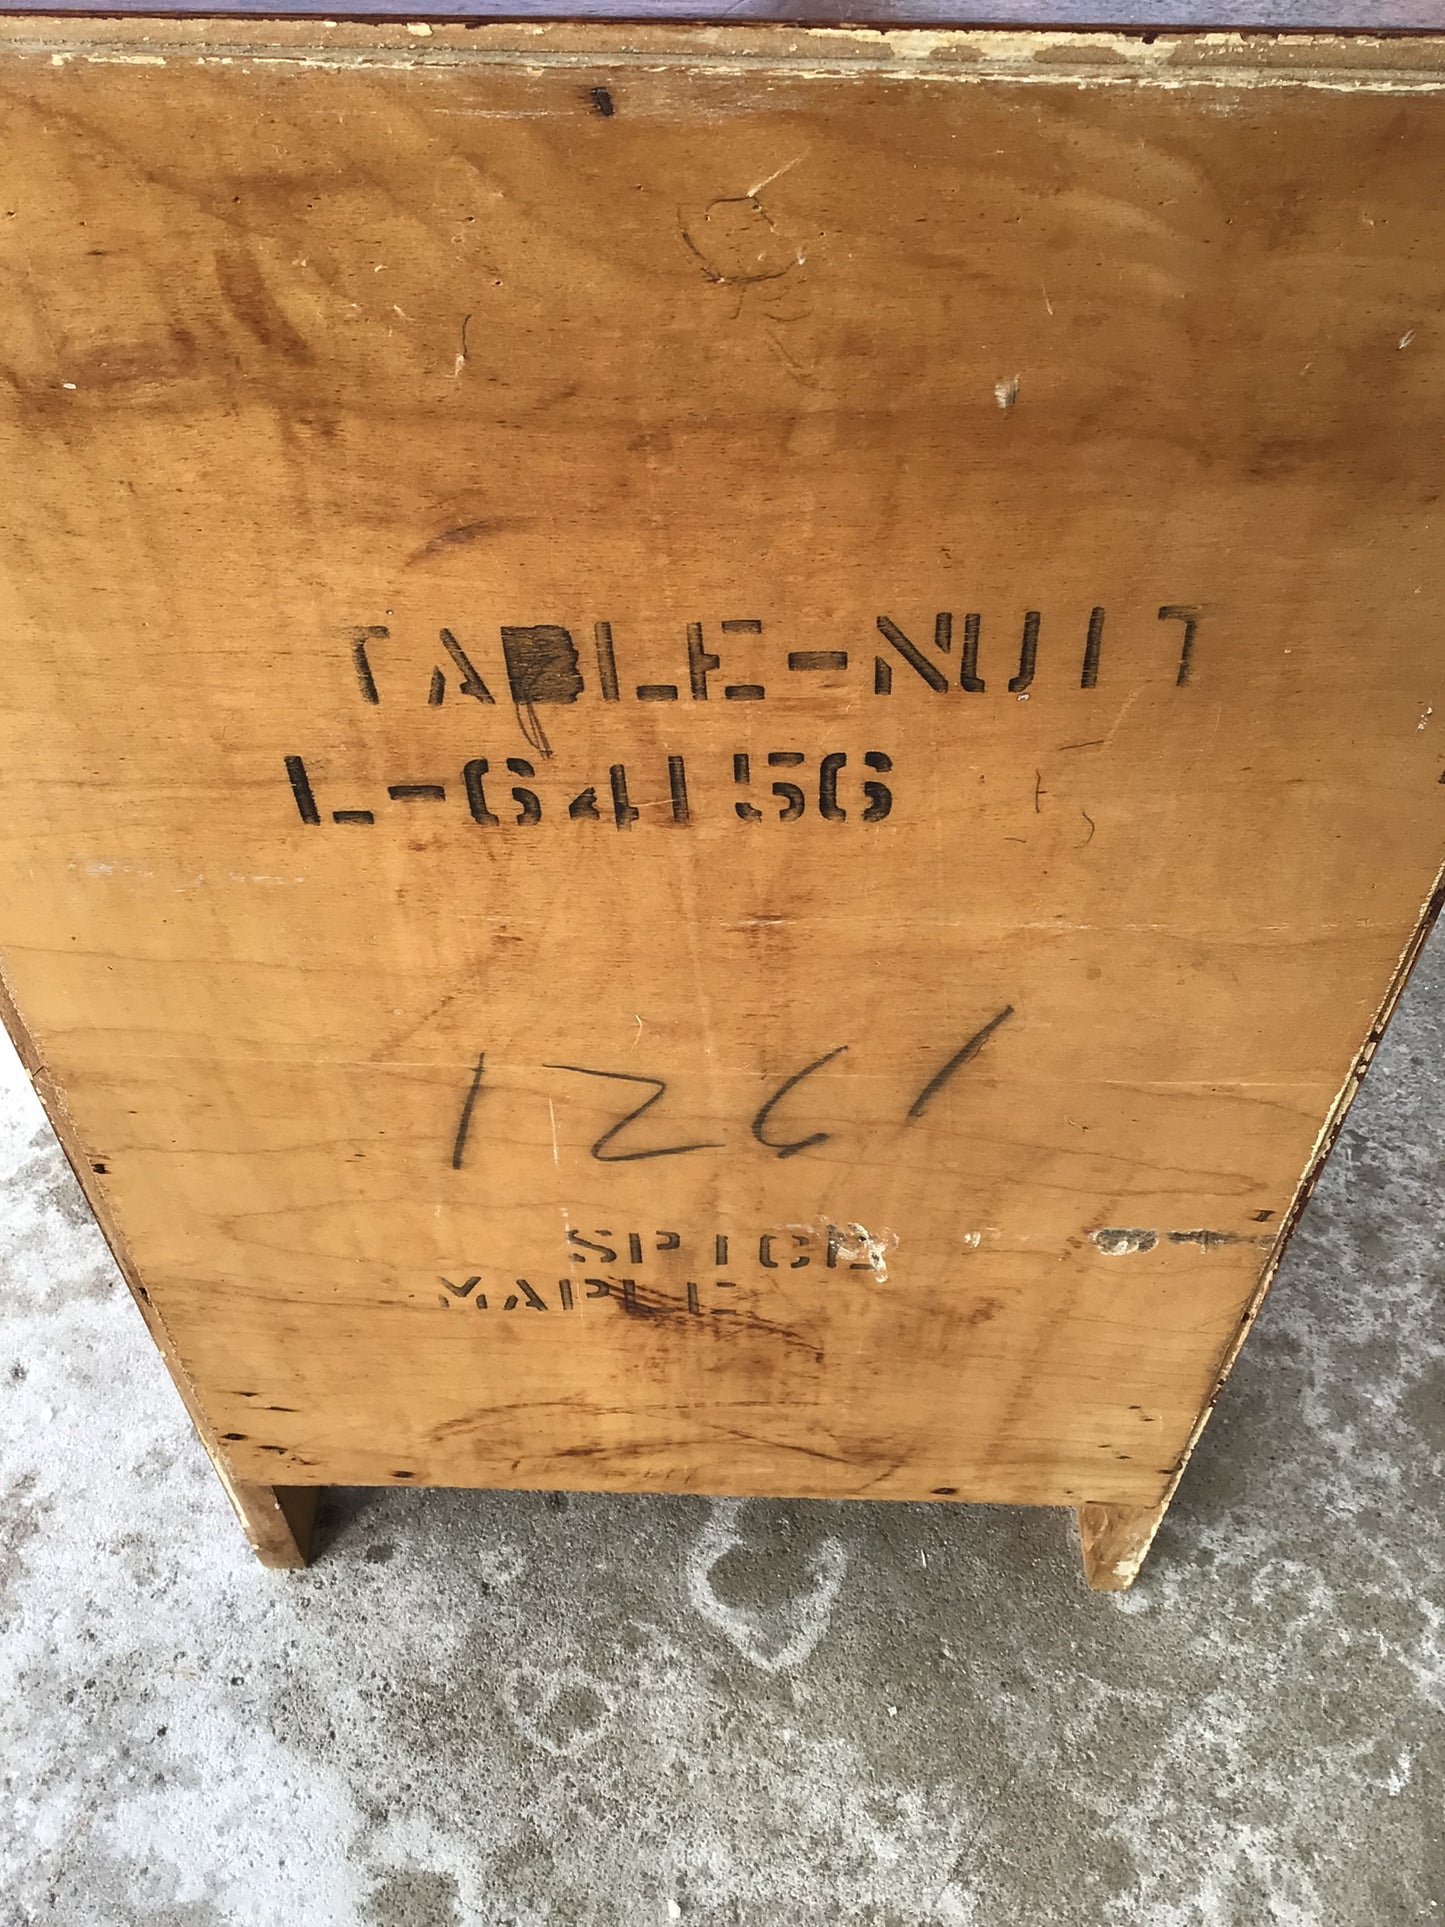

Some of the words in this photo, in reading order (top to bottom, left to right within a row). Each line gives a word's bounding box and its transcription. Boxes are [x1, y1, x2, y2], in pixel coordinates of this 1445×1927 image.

[284, 751, 893, 831] L-64156
[567, 1224, 876, 1270] SPICE
[437, 1275, 737, 1314] MAPLE
